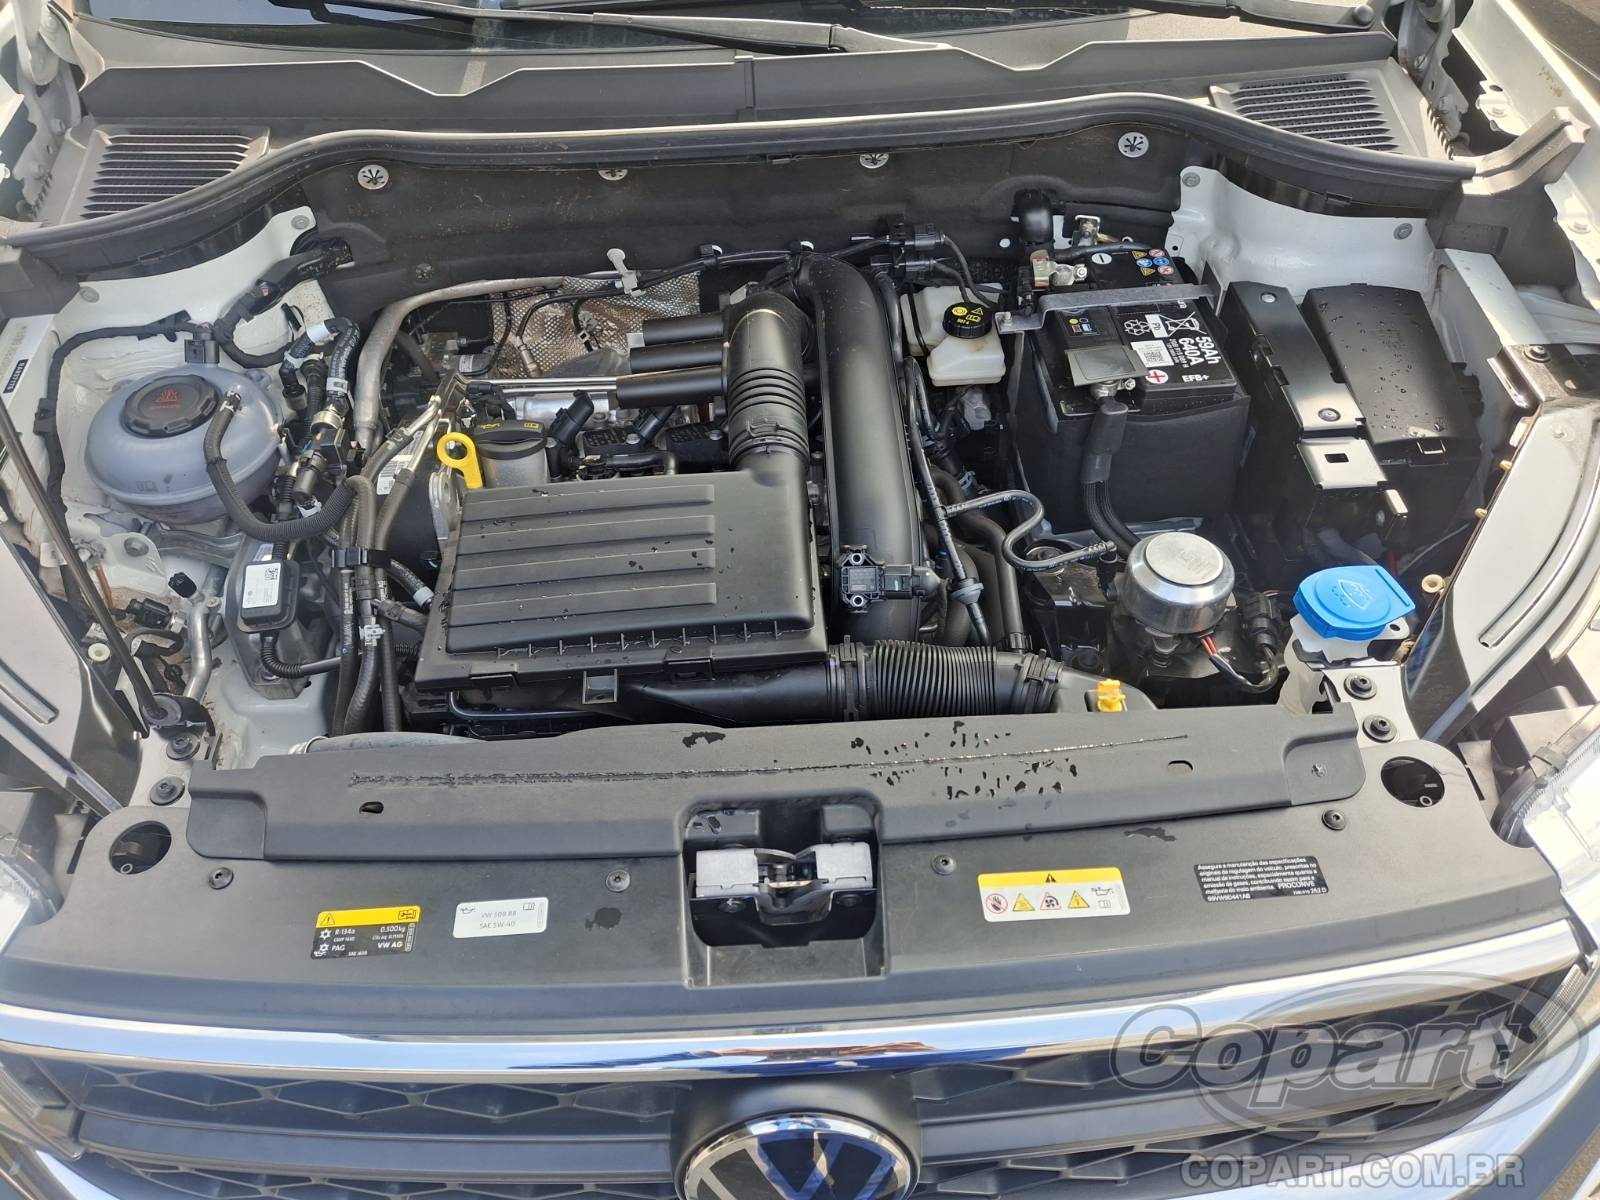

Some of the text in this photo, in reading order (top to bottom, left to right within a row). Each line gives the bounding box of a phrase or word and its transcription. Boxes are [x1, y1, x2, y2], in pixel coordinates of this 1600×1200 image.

[1151, 322, 1161, 331] Pb
[1178, 337, 1205, 366] 640A
[1195, 336, 1222, 364] 59Ah
[1181, 374, 1210, 382] EFB+
[1277, 880, 1315, 889] PROCONVE
[479, 922, 492, 930] SAE
[331, 944, 346, 952] PAG
[390, 941, 404, 949] AG
